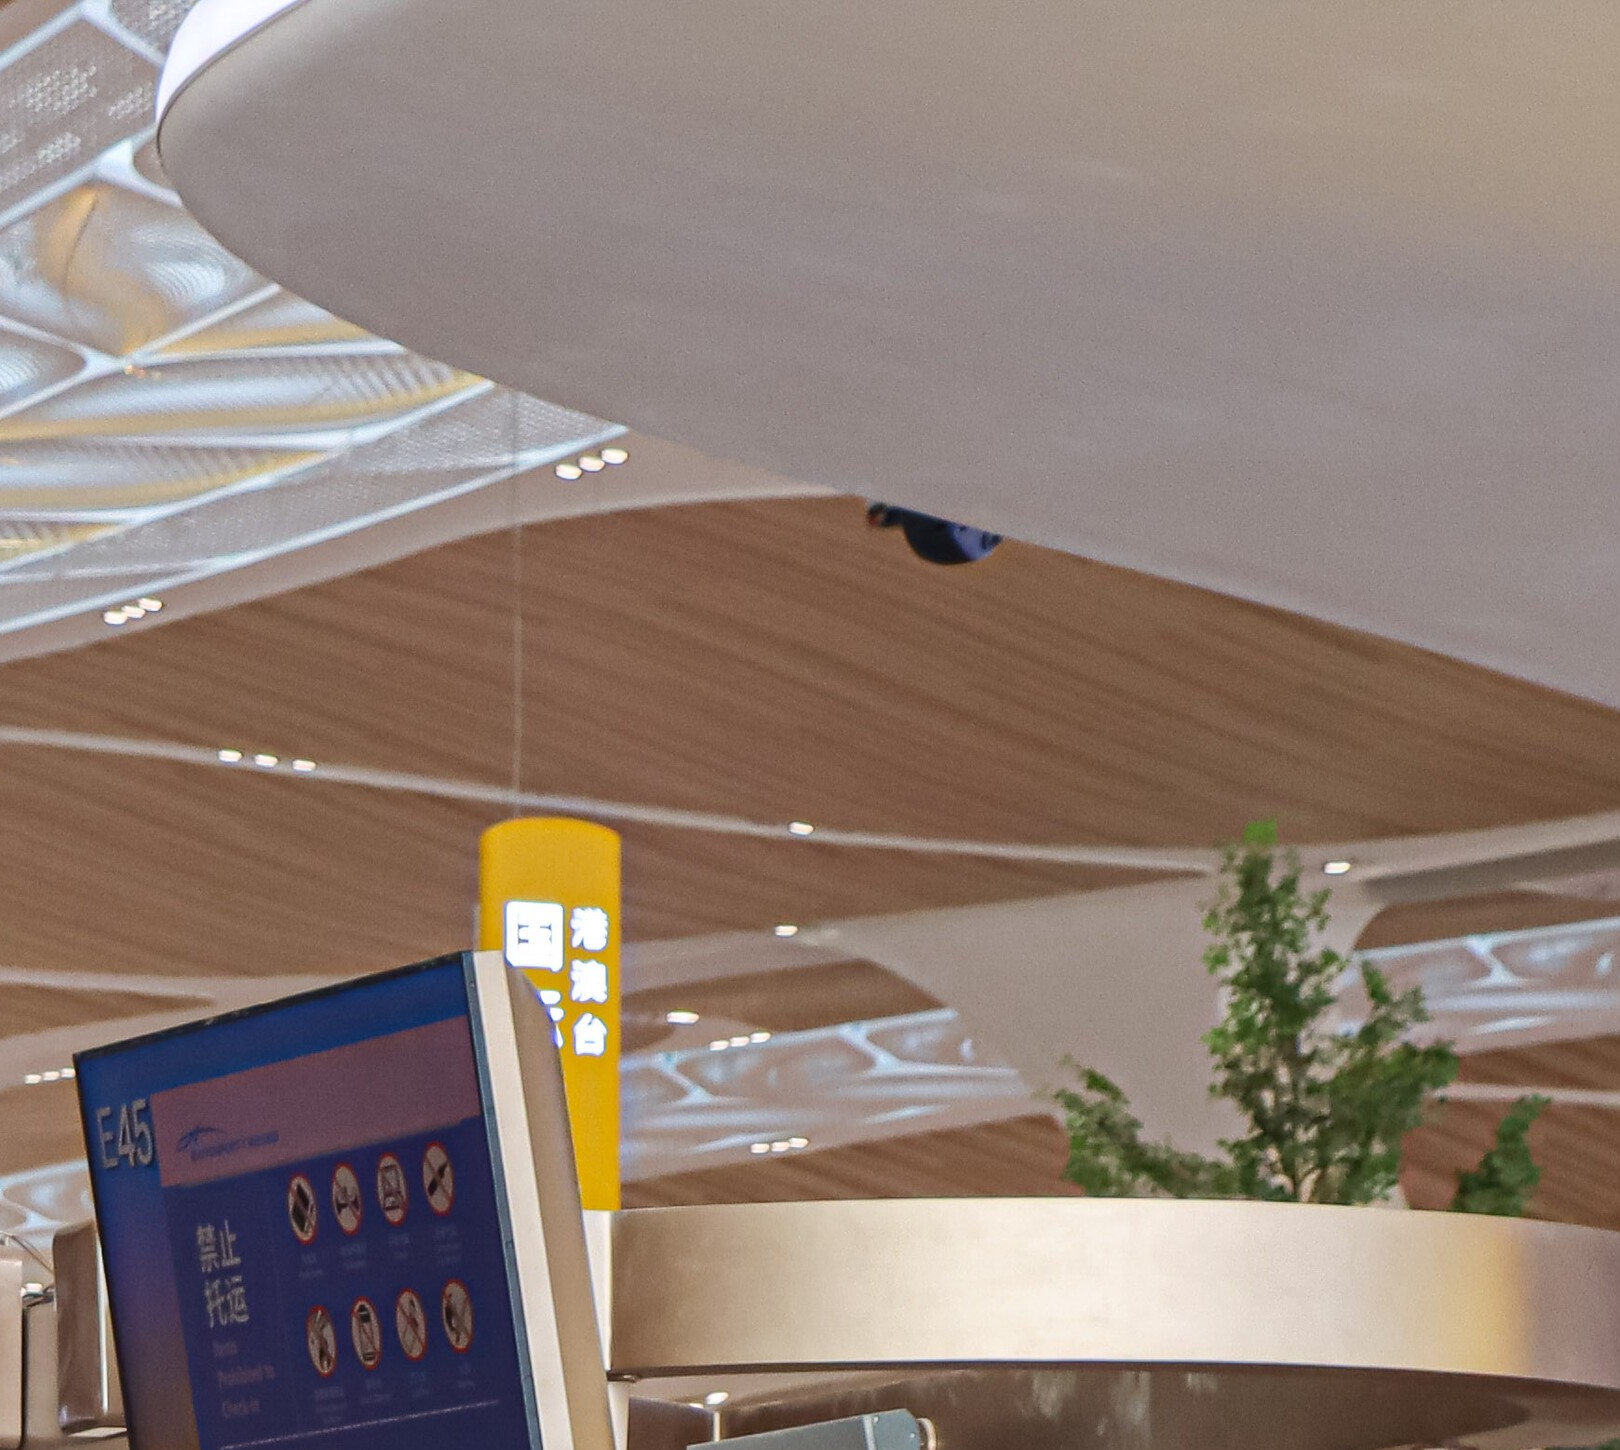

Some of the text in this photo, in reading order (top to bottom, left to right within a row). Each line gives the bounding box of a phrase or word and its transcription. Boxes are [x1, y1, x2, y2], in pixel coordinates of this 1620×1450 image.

[570, 907, 609, 1056] 港澳台
[97, 1099, 155, 1169] E45
[196, 1219, 243, 1271] 禁止
[205, 1273, 251, 1329] 托运
